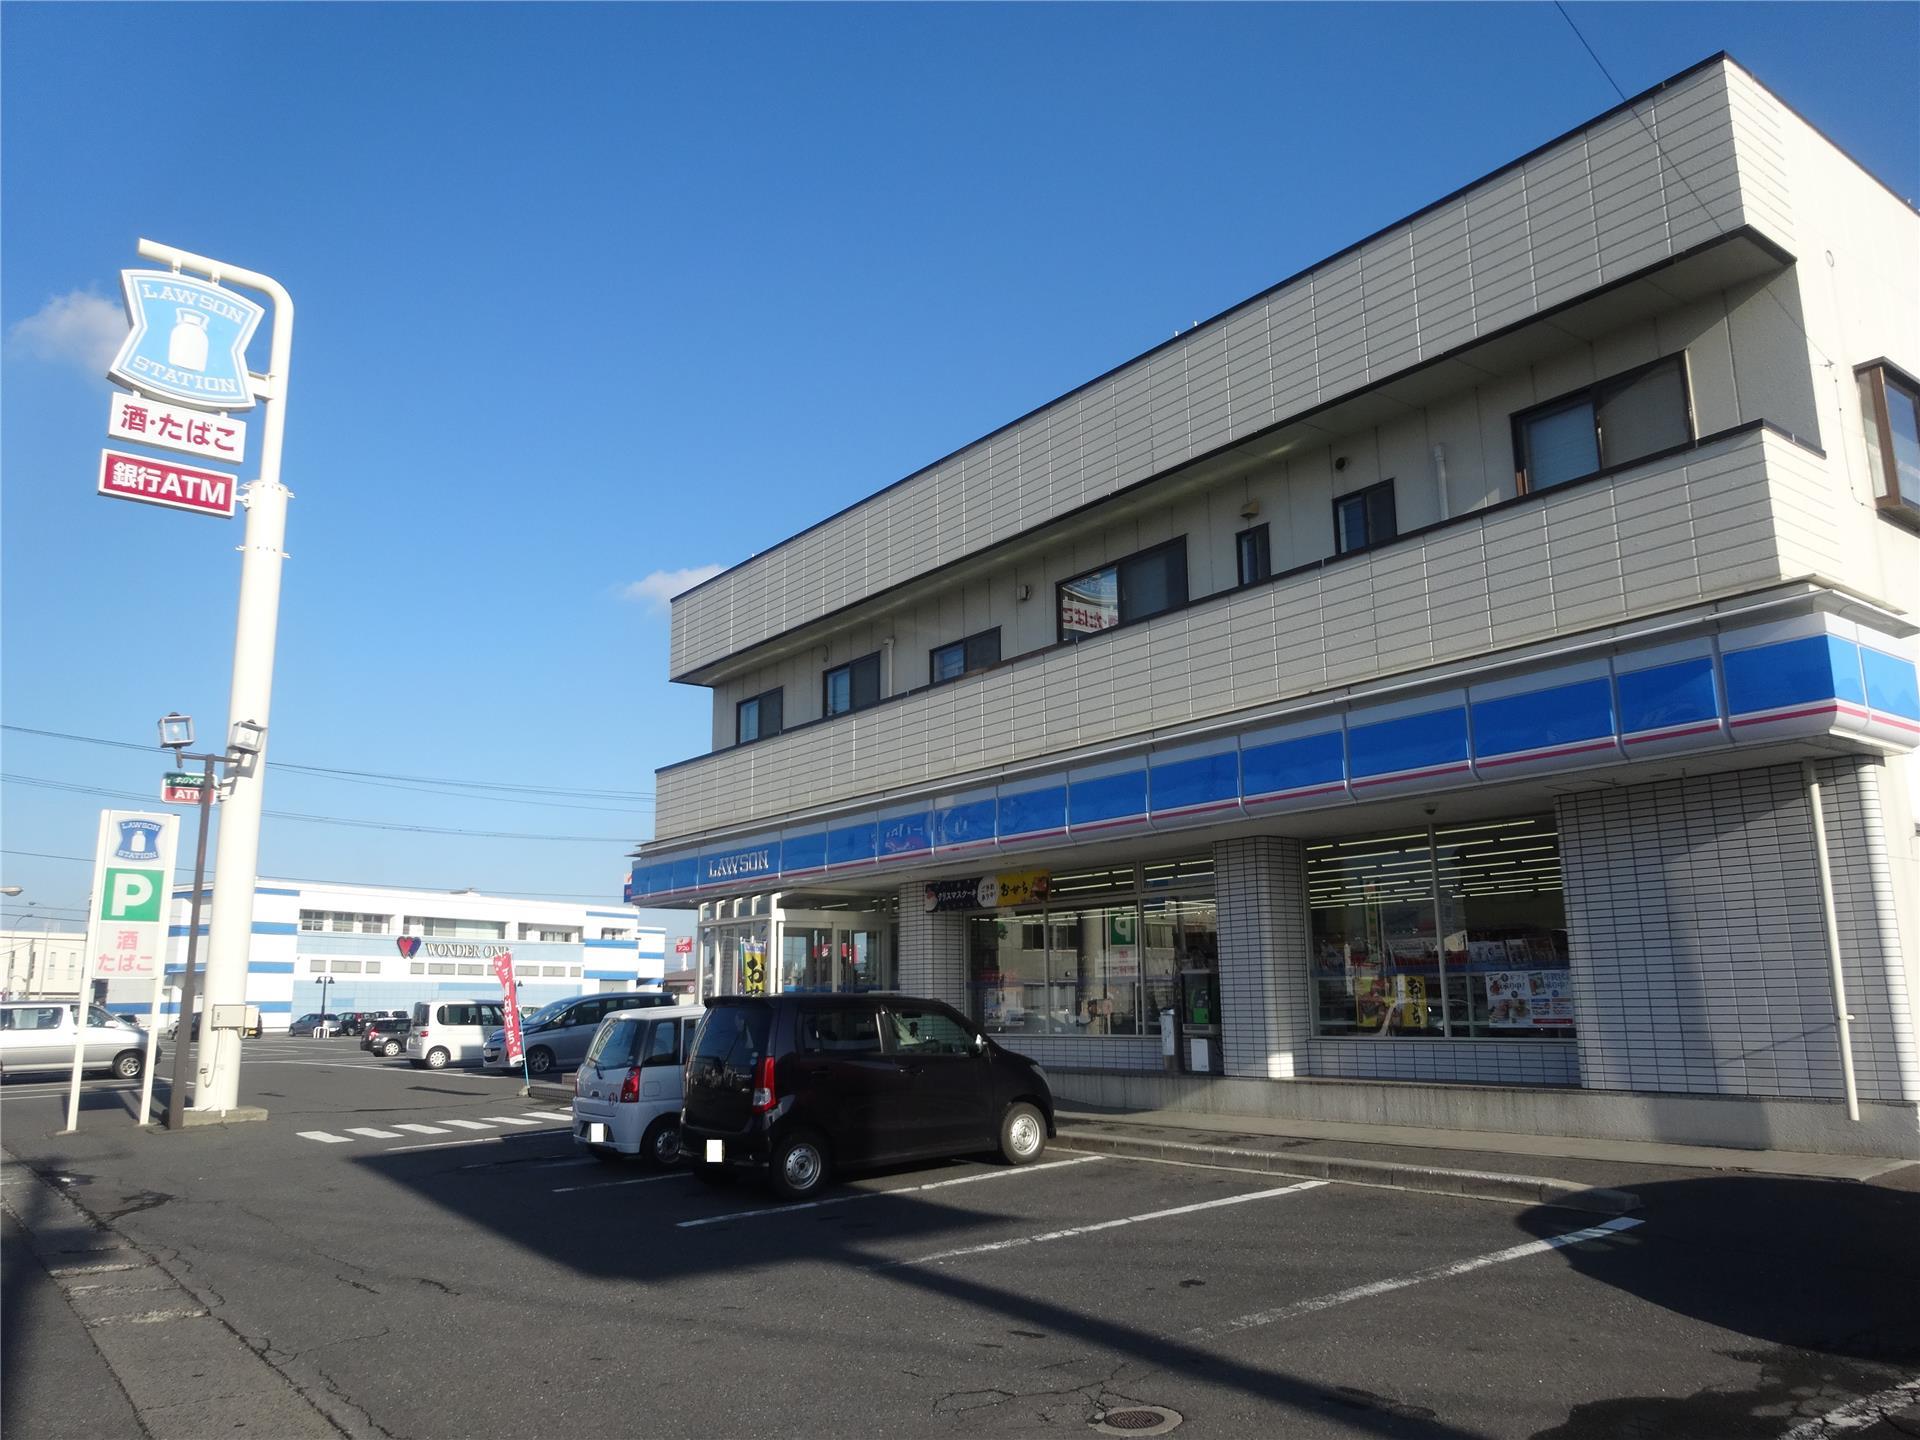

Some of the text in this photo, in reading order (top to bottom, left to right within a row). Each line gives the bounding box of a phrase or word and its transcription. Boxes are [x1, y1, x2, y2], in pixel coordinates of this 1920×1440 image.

[141, 284, 245, 325] LAWSON
[132, 355, 237, 394] STATION
[121, 403, 236, 452] 酒・たばこ
[112, 461, 226, 505] 銀行ATM
[121, 821, 161, 832] LAWSON
[117, 849, 157, 860] STATION
[708, 850, 769, 878] LAWSON
[111, 873, 153, 916] P
[116, 931, 138, 951] 酒
[425, 943, 481, 958] WONDER
[98, 953, 154, 973] たばこ
